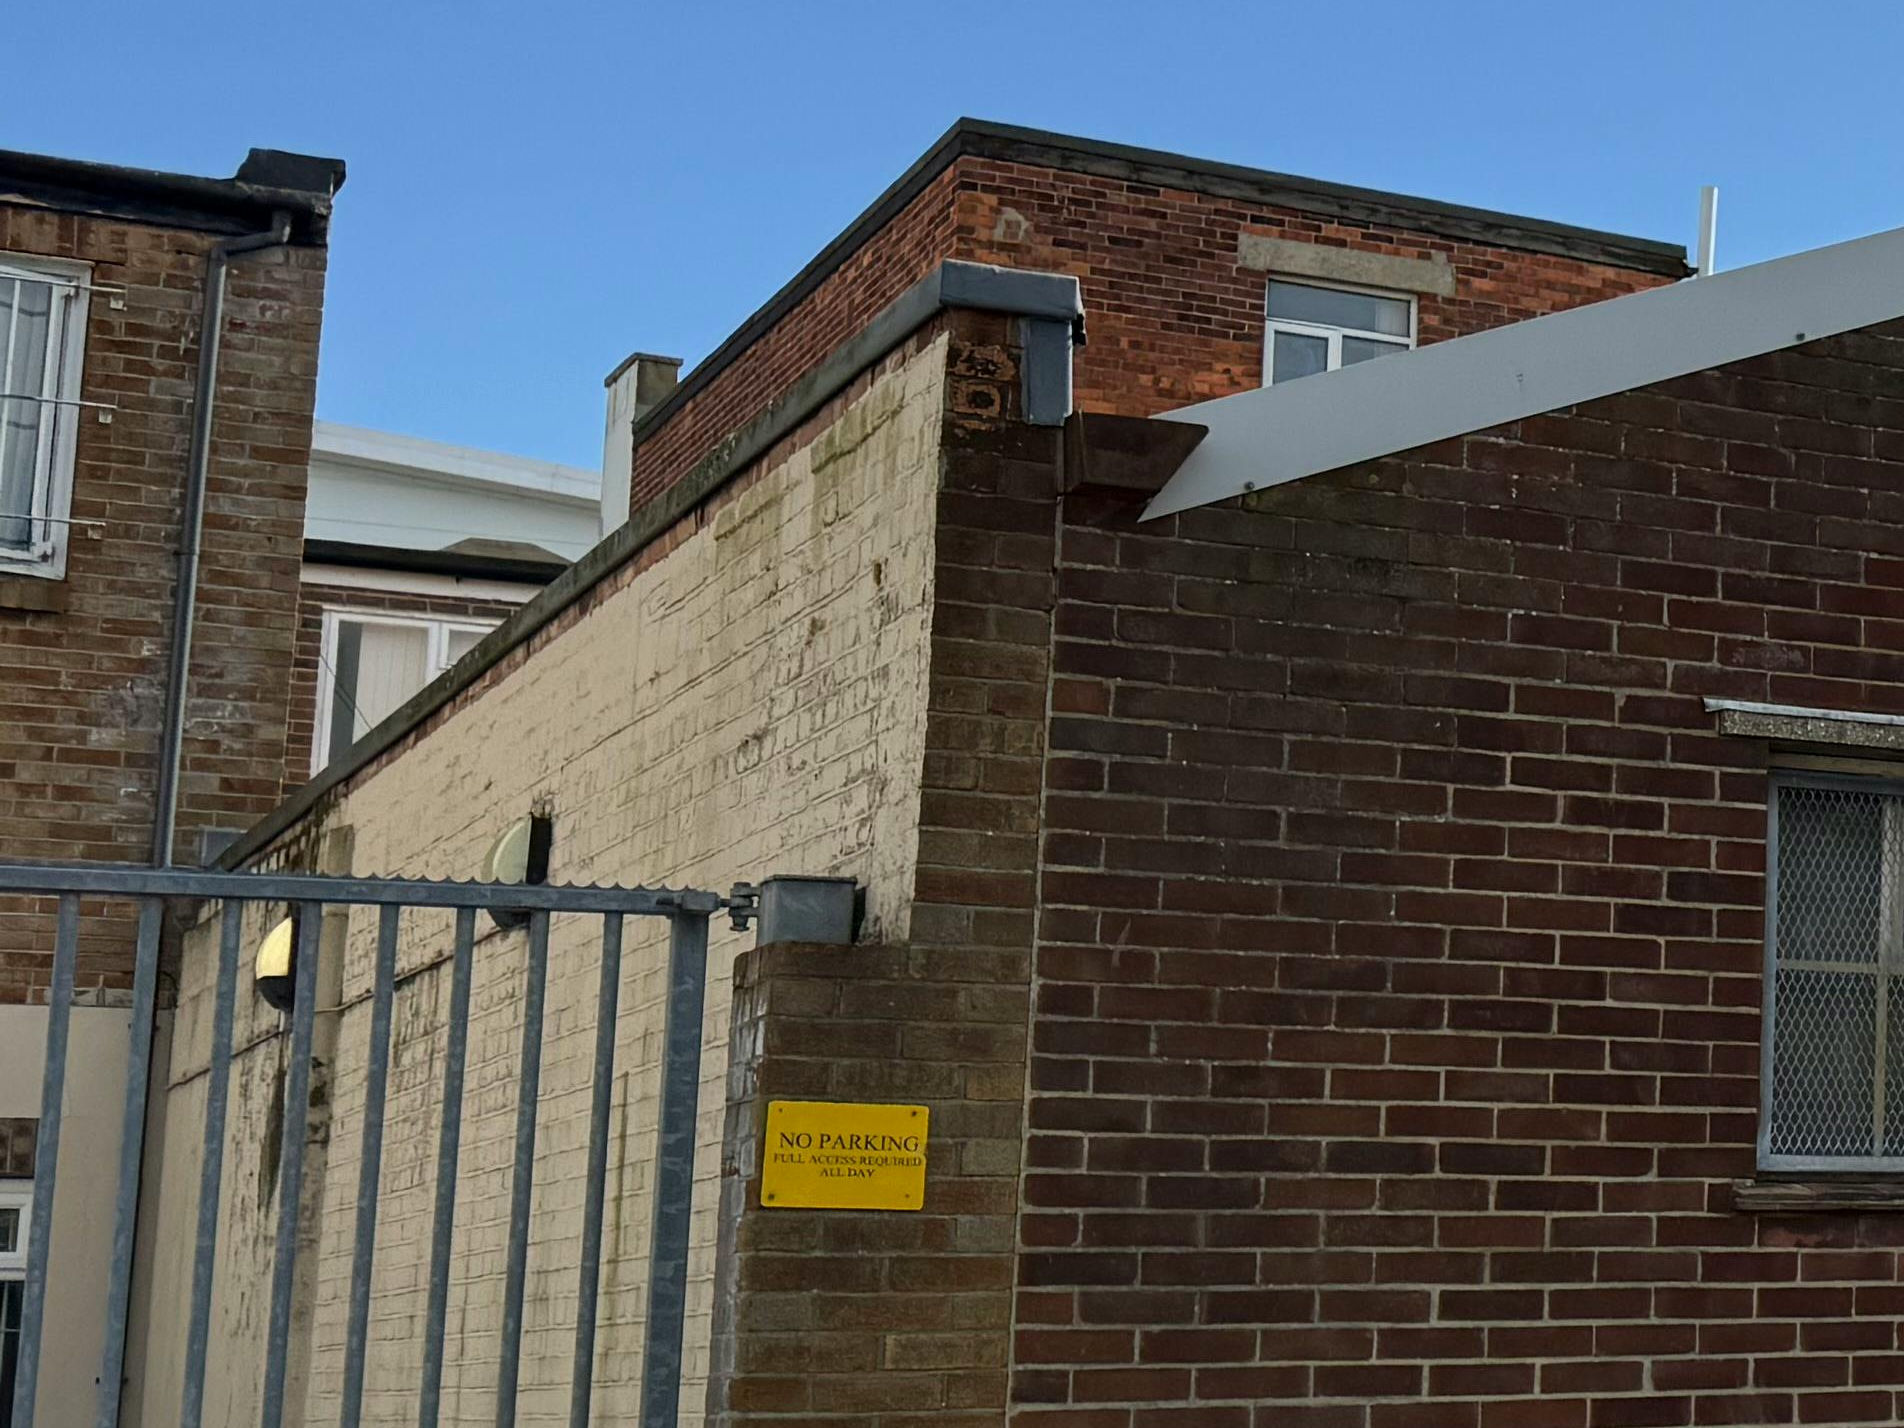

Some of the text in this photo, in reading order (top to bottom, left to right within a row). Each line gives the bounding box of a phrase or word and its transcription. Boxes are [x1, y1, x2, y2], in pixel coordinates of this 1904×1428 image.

[779, 1131, 920, 1152] NO PARKING
[773, 1152, 922, 1167] FULL ACCESS REQUIRED
[820, 1167, 876, 1179] ALL DAY
